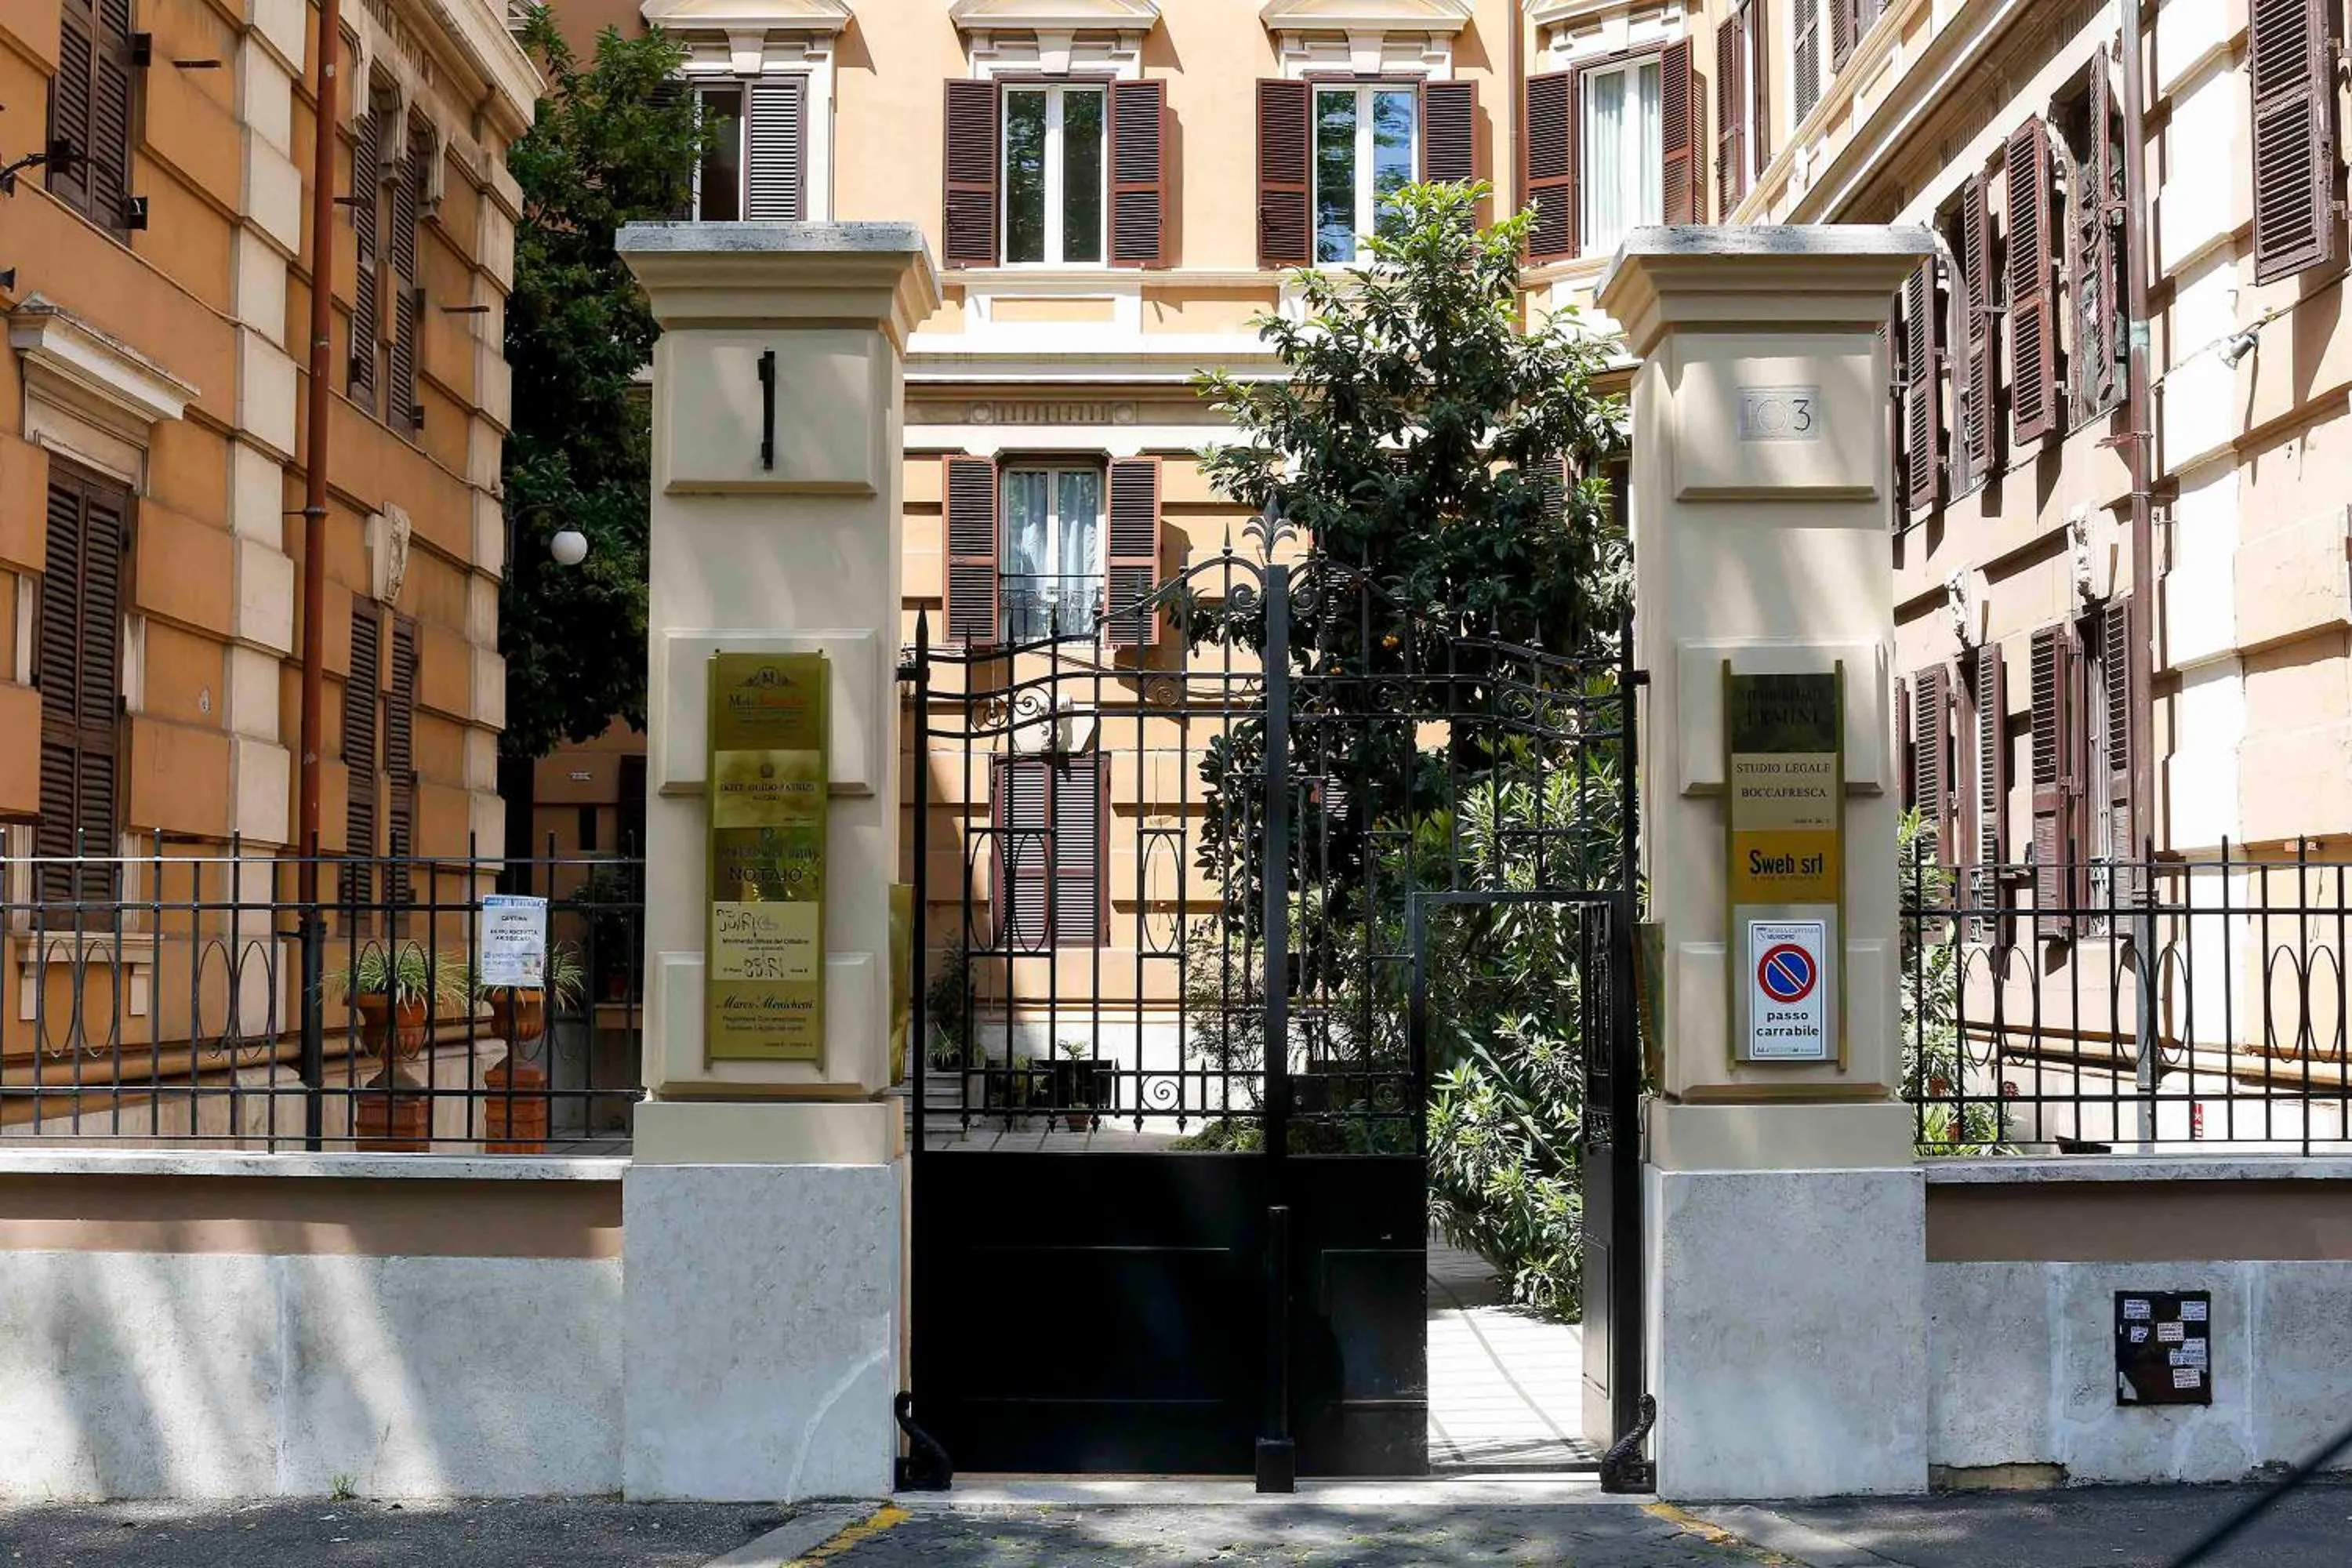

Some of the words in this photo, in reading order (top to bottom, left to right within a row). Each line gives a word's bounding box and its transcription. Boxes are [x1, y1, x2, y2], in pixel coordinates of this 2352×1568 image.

[1736, 763, 1780, 773] STUDIO
[1784, 763, 1831, 773] LEGALE
[1740, 787, 1828, 798] BOCCAFRESCA
[1748, 848, 1795, 875] Sweb
[1800, 852, 1823, 875] srl
[729, 866, 803, 883] NOTAIO
[1766, 1011, 1809, 1023] passo
[1756, 1024, 1819, 1037] carrabile
